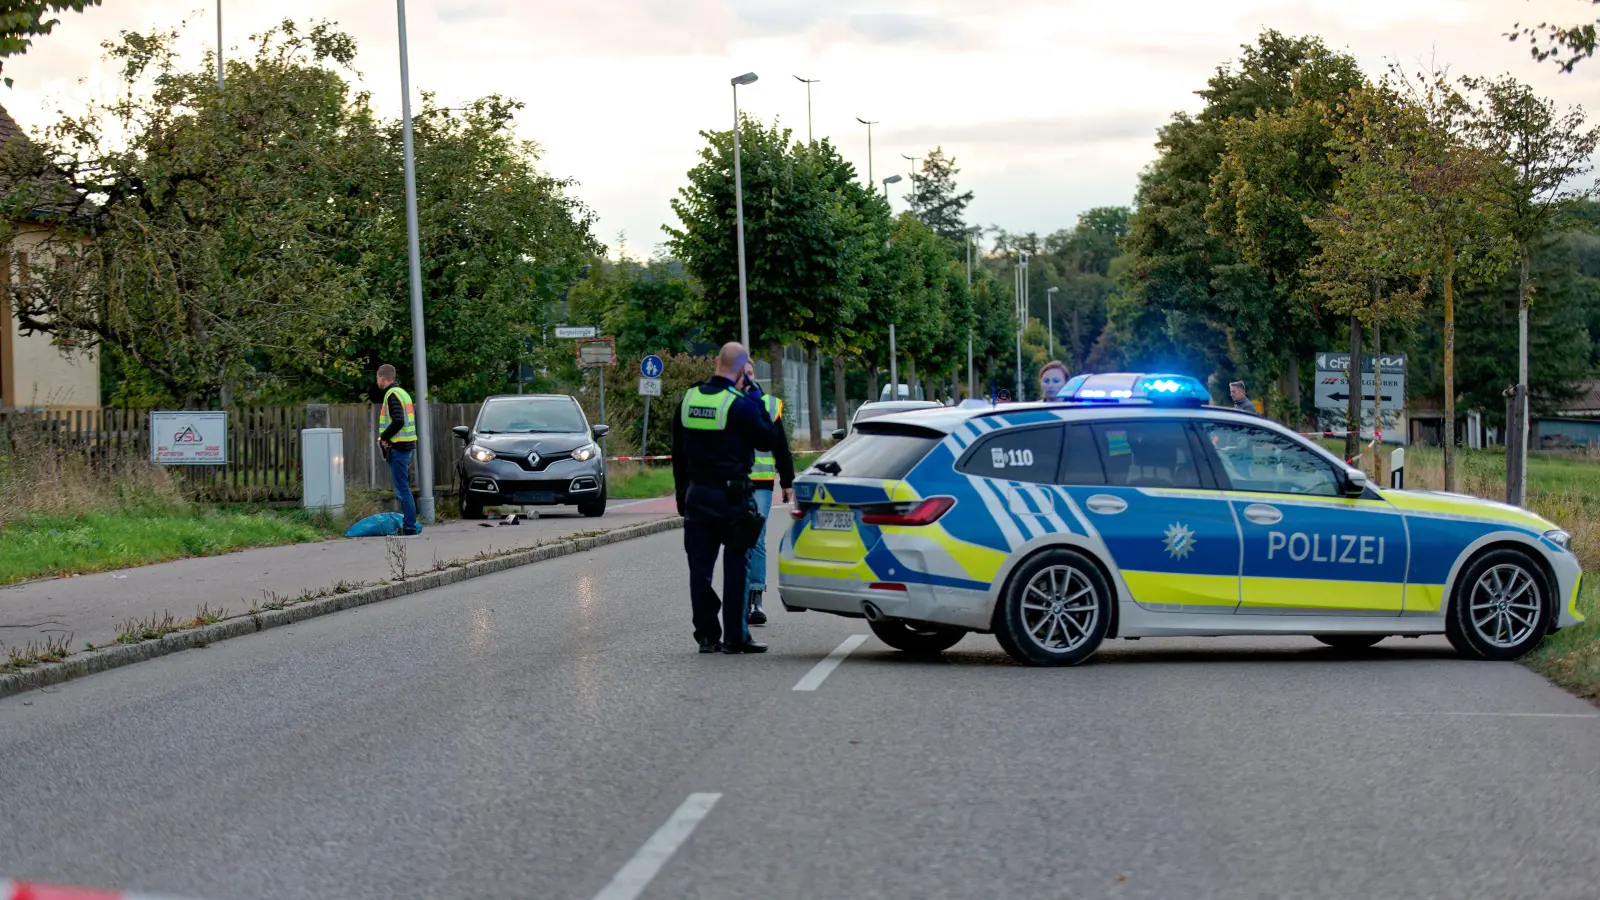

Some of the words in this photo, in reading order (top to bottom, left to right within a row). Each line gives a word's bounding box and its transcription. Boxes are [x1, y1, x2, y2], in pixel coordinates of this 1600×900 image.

[689, 407, 716, 418] POLIZEI
[1008, 449, 1034, 467] 110
[1267, 531, 1385, 565] POLIZEI
